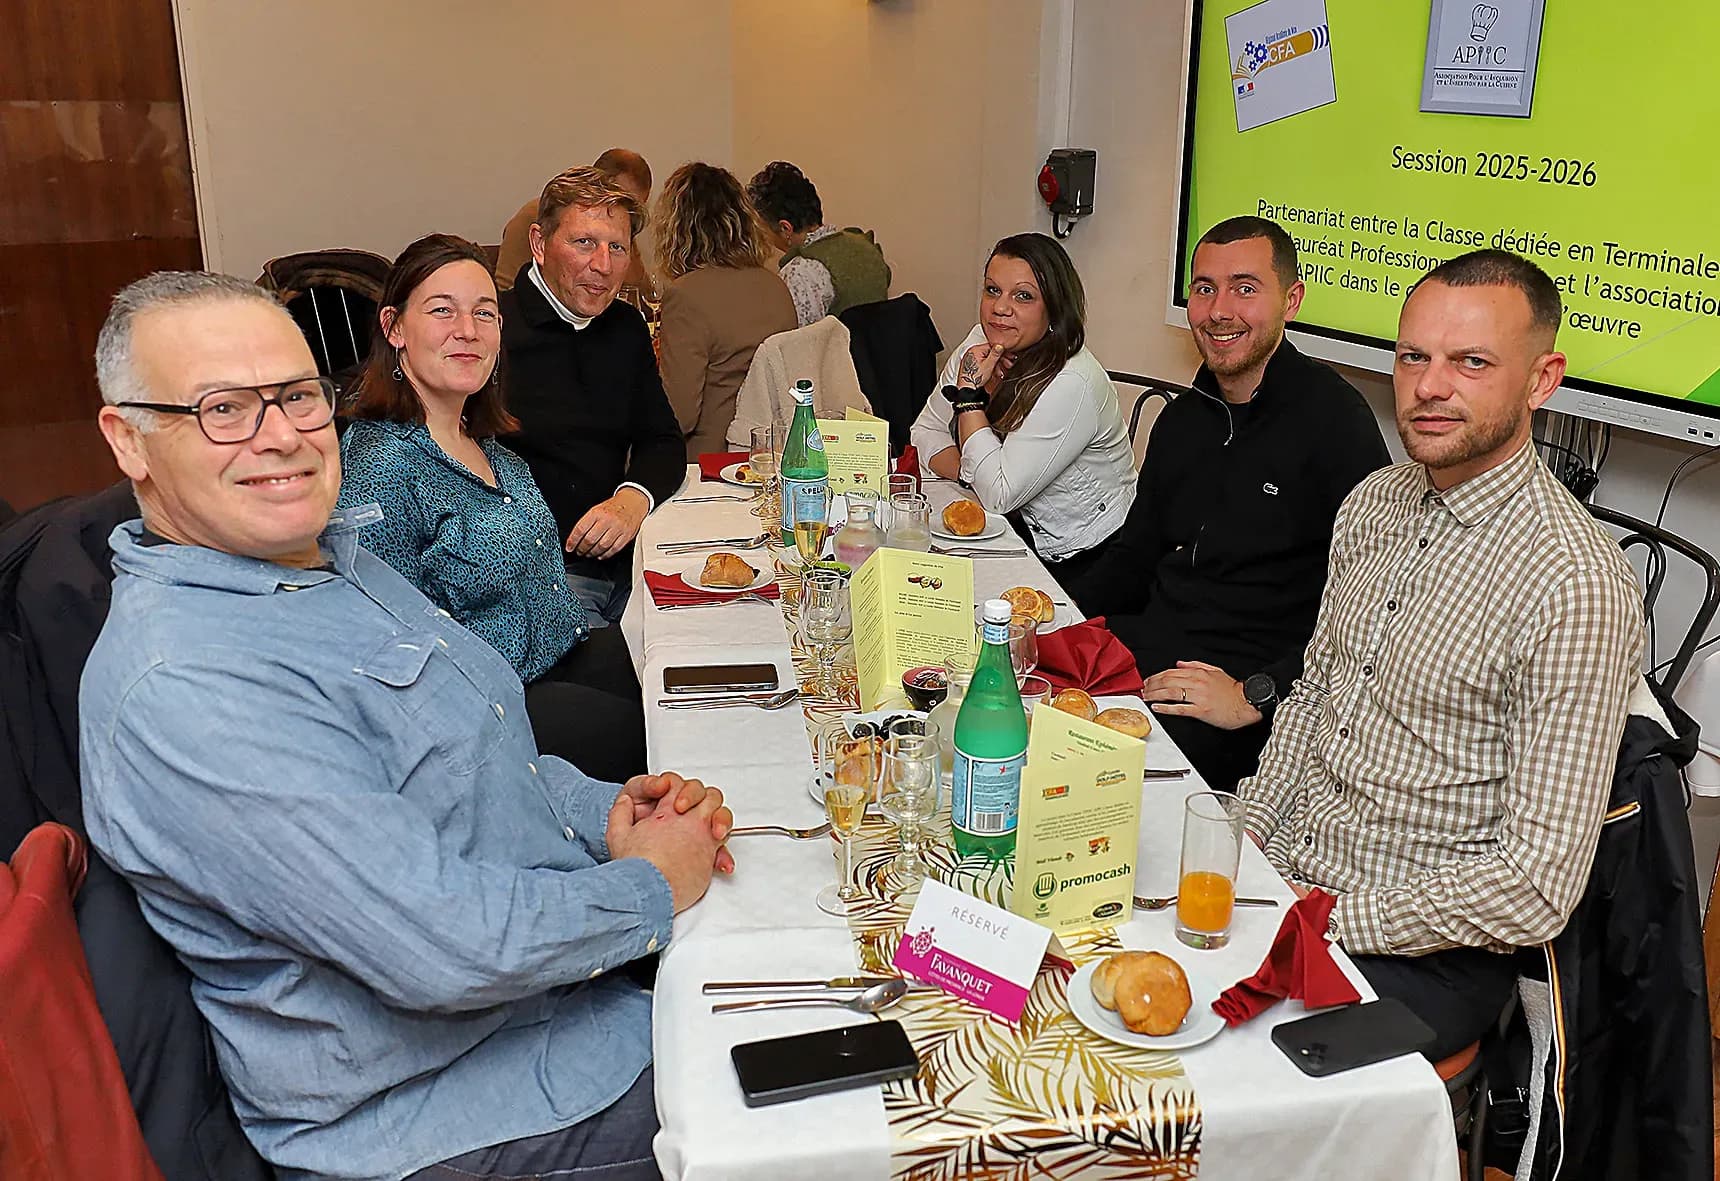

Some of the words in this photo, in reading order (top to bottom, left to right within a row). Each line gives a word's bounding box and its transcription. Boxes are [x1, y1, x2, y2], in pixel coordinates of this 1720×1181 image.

[1268, 41, 1296, 63] CFA
[1391, 145, 1467, 175] Session
[1474, 152, 1597, 187] 2025-2026
[1257, 199, 1345, 229] Partenariat
[1350, 214, 1398, 236] entre
[1403, 217, 1419, 239] la
[1426, 221, 1485, 248] Classe
[1491, 228, 1561, 258] dédiée
[1568, 243, 1594, 263] en
[1603, 241, 1720, 279] Terminale
[1290, 231, 1345, 259] auréat
[1350, 241, 1447, 272] Profession
[1340, 269, 1378, 294] dans
[1384, 275, 1401, 297] le
[1553, 273, 1577, 294] et
[1562, 304, 1642, 339] ’œuvre
[1060, 863, 1131, 892] promocash
[950, 905, 1010, 941] RÉSERVÉ
[929, 952, 994, 995] FAVANQUET
